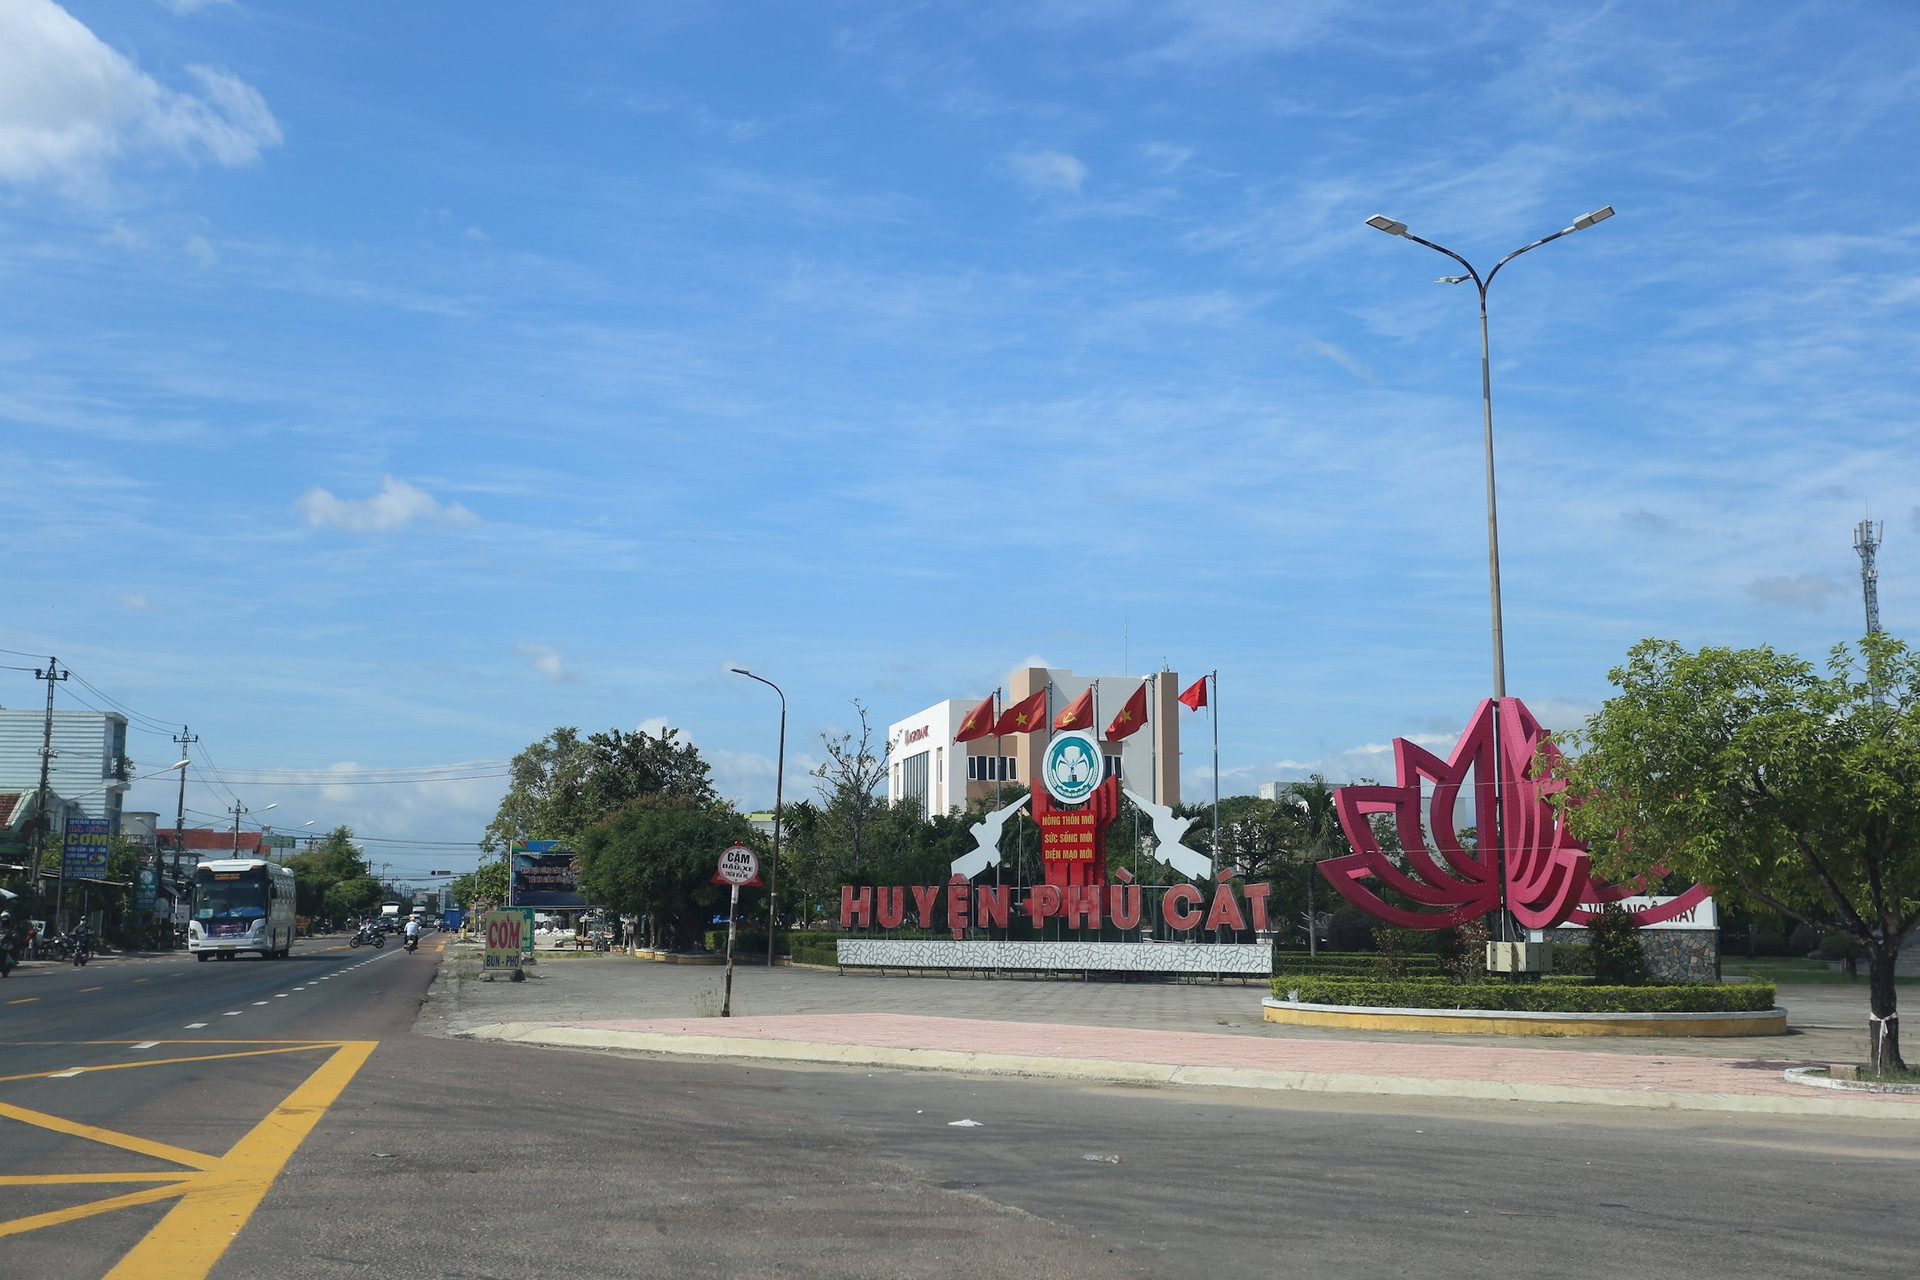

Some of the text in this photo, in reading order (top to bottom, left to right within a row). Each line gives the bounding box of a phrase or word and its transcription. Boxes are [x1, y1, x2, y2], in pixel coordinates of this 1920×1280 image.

[1042, 813, 1094, 826] NÔNG THÔN MỚI
[67, 832, 108, 846] CƠM
[1044, 831, 1092, 843] SỨC SỐNG MỚI
[728, 850, 750, 864] CẤM
[1045, 848, 1092, 861] DIỆN MẠO MỚI
[840, 866, 1272, 940] HUYỆN PHÙ CÁT
[488, 912, 521, 949] CƠM
[486, 952, 500, 967] BÚN
[506, 951, 519, 967] PHỞ
